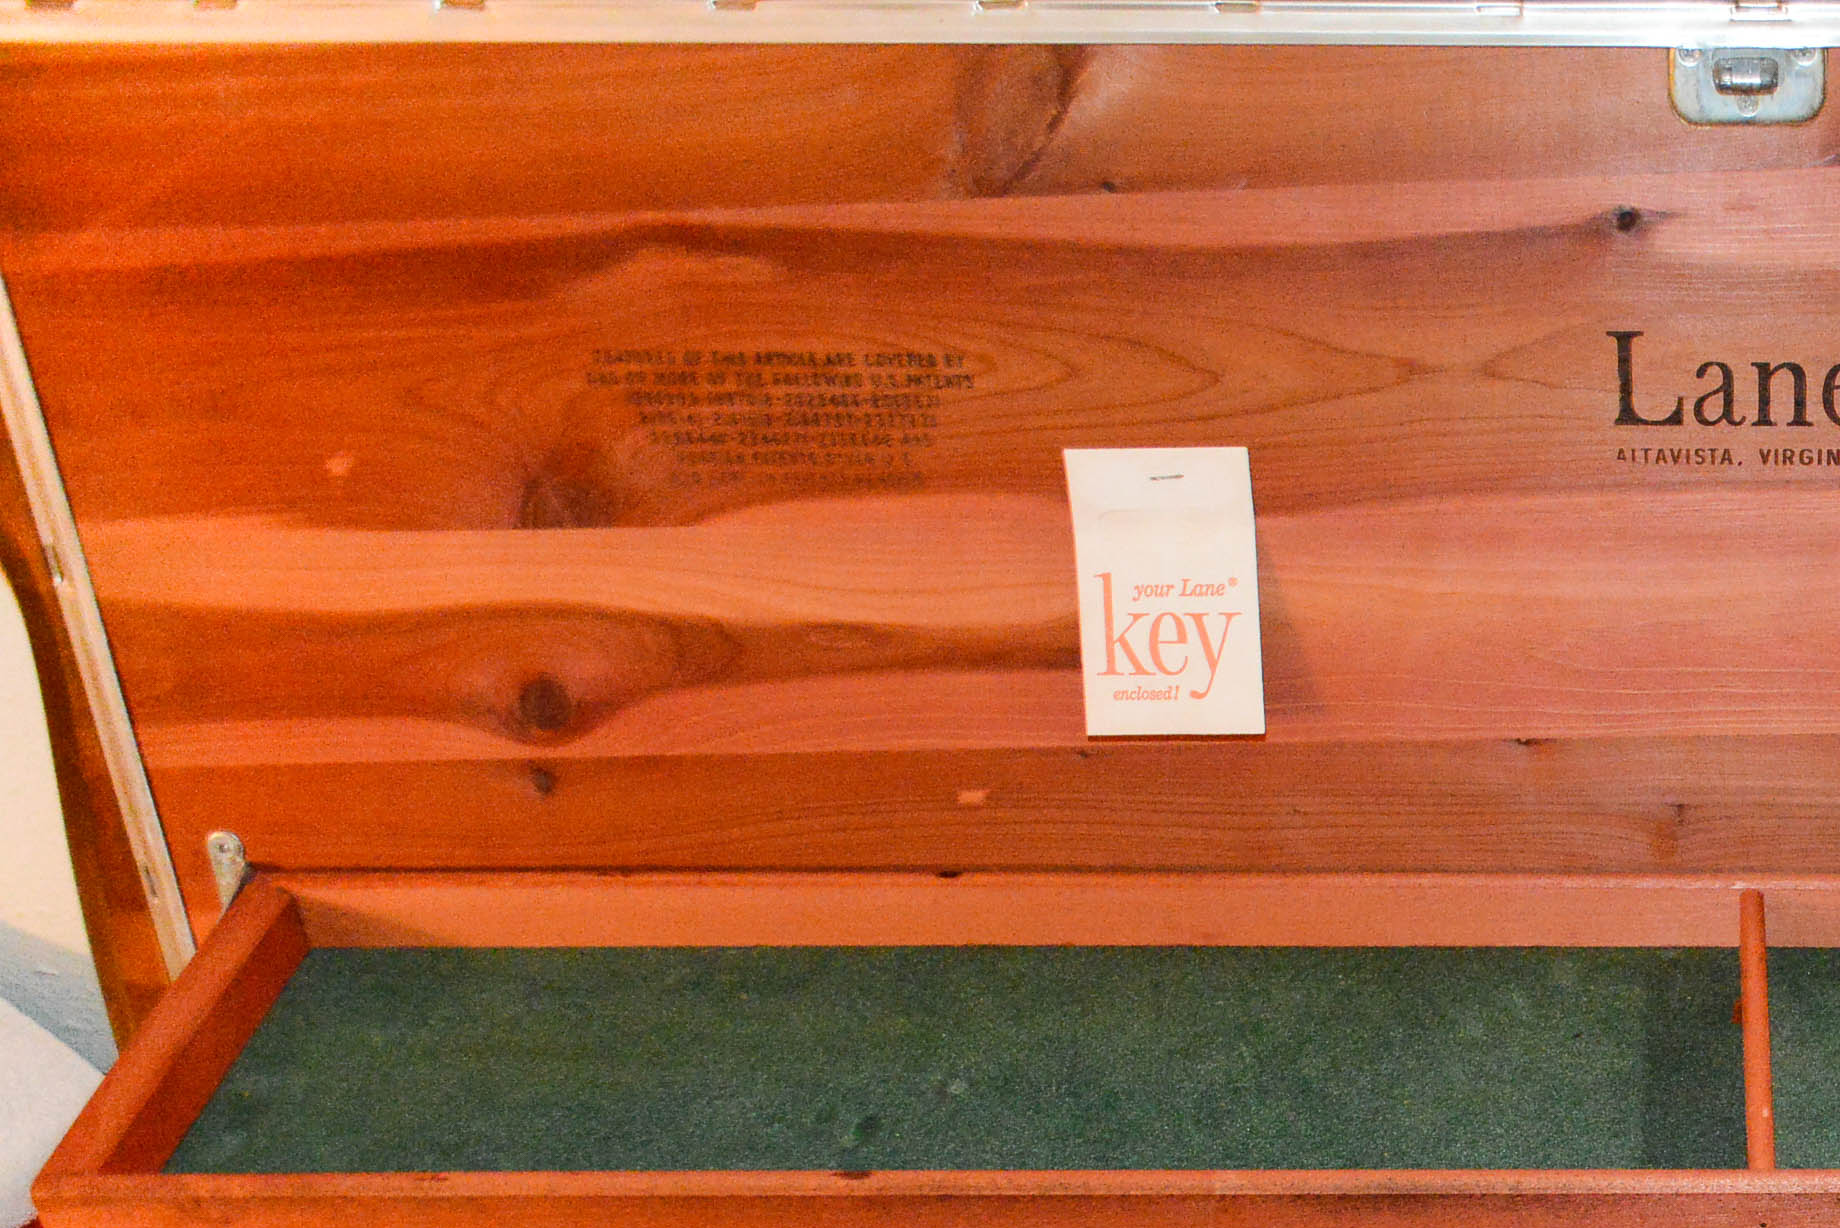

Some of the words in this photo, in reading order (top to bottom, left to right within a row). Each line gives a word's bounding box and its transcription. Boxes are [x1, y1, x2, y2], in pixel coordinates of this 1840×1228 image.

[1132, 583, 1175, 602] your
[1093, 572, 1243, 699] key
[1113, 685, 1179, 701] enclosed!
